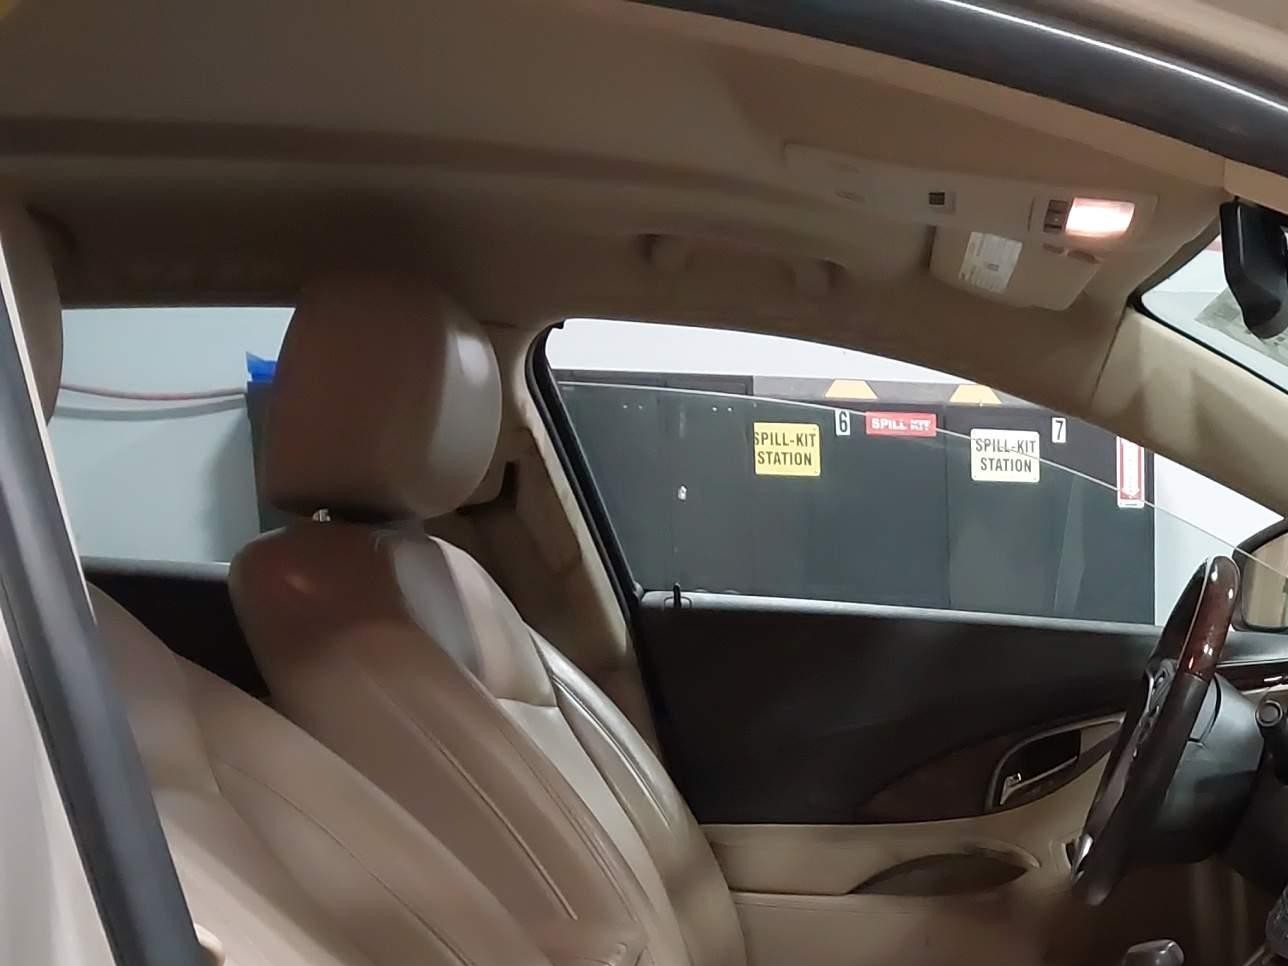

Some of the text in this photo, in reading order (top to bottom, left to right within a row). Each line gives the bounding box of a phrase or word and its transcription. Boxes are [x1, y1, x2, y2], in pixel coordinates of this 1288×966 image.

[839, 411, 848, 433] 6
[871, 417, 908, 432] SPILL
[1055, 419, 1064, 441] 7
[754, 431, 817, 448] SPILL-KIT
[974, 438, 1037, 454] SPILL-KIT
[757, 451, 813, 466] STATION
[980, 457, 1033, 473] STATION
